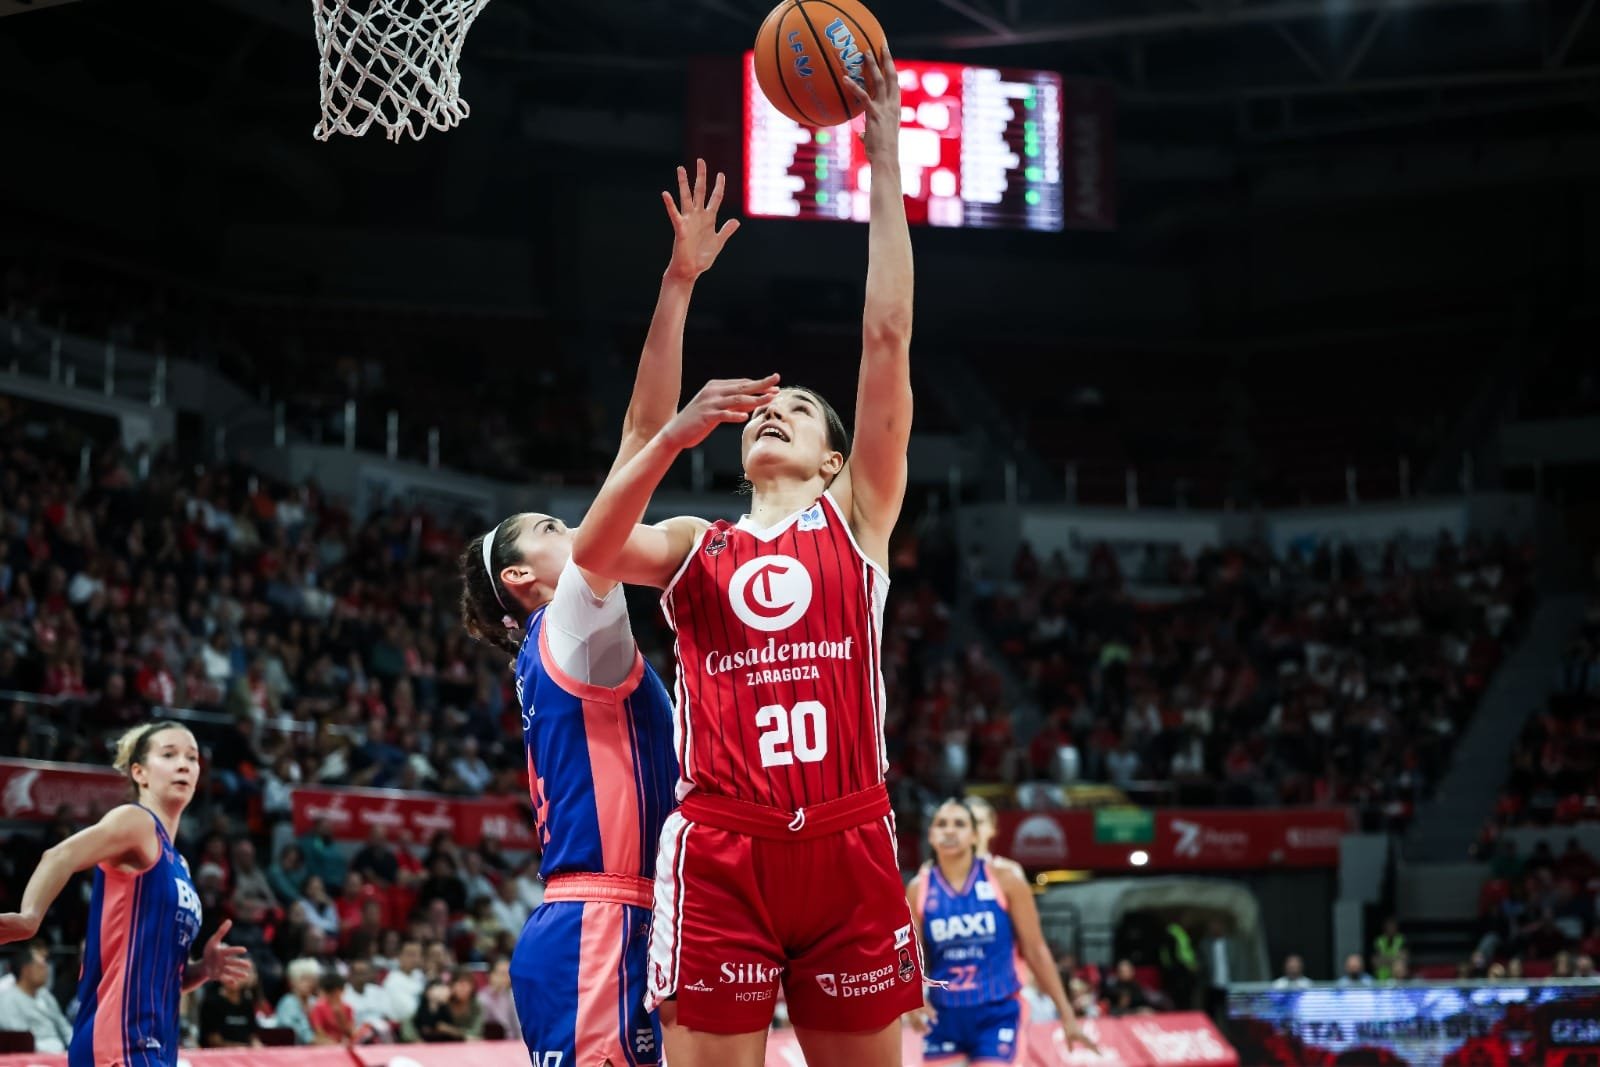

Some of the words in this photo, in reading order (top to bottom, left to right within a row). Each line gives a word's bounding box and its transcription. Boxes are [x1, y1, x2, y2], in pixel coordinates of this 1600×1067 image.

[706, 636, 855, 676] Casademont
[746, 665, 820, 686] ZARAGOZA
[755, 700, 828, 768] 20
[930, 911, 996, 943] BAXI
[840, 964, 894, 985] Zaragoza
[842, 977, 896, 998] DEPORTE
[947, 965, 977, 992] 22
